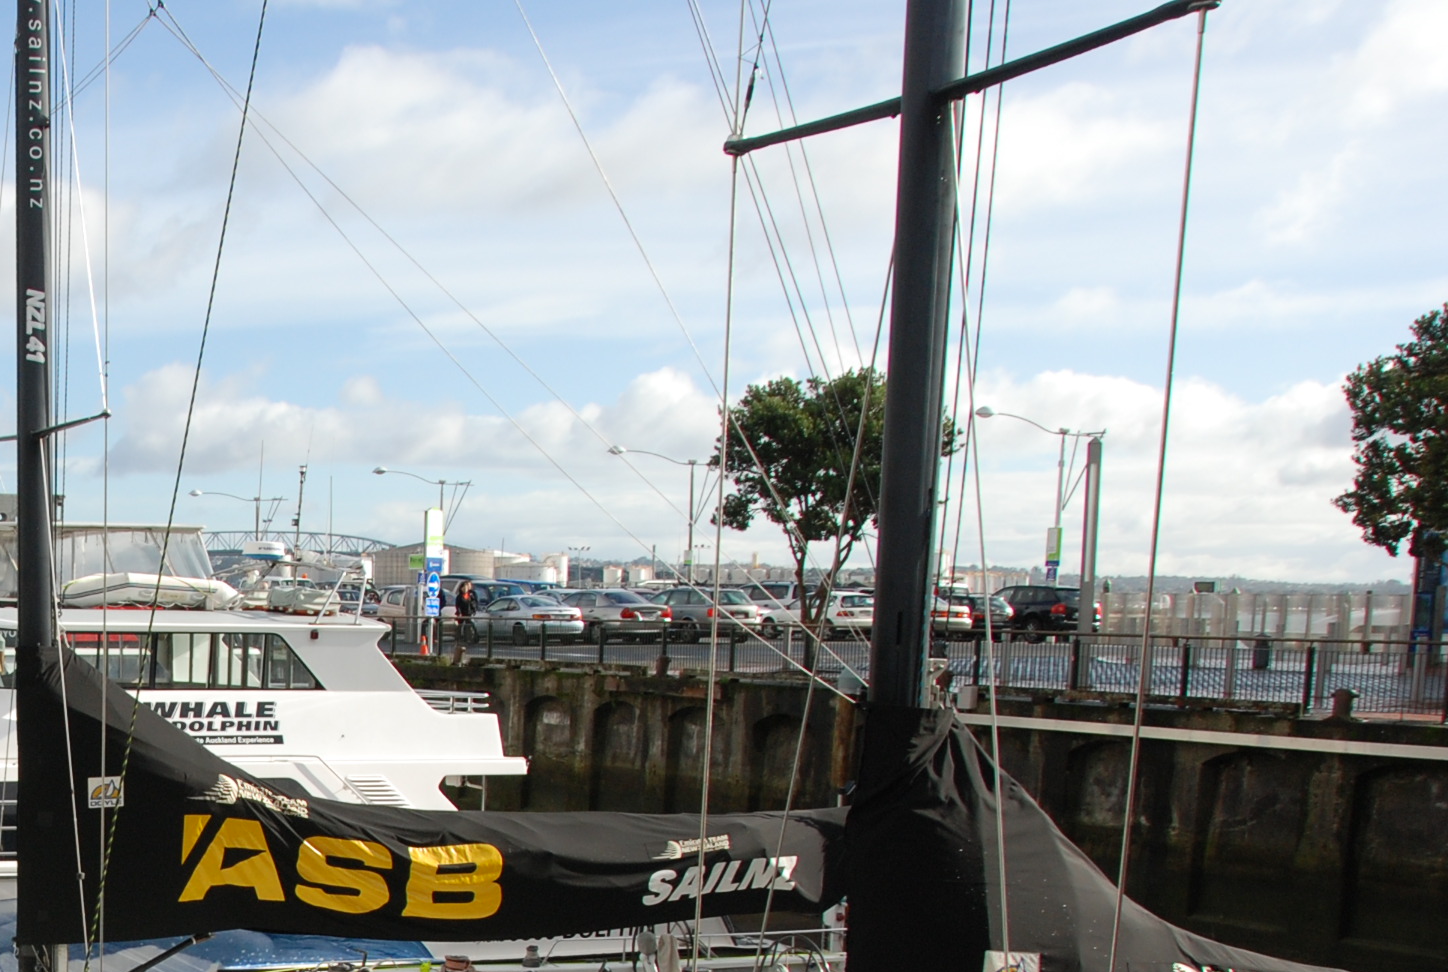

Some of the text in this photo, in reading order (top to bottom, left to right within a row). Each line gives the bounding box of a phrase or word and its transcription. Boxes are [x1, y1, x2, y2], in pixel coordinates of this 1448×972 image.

[144, 701, 277, 719] WHALE
[238, 737, 274, 745] Experience
[178, 814, 503, 920] ASB
